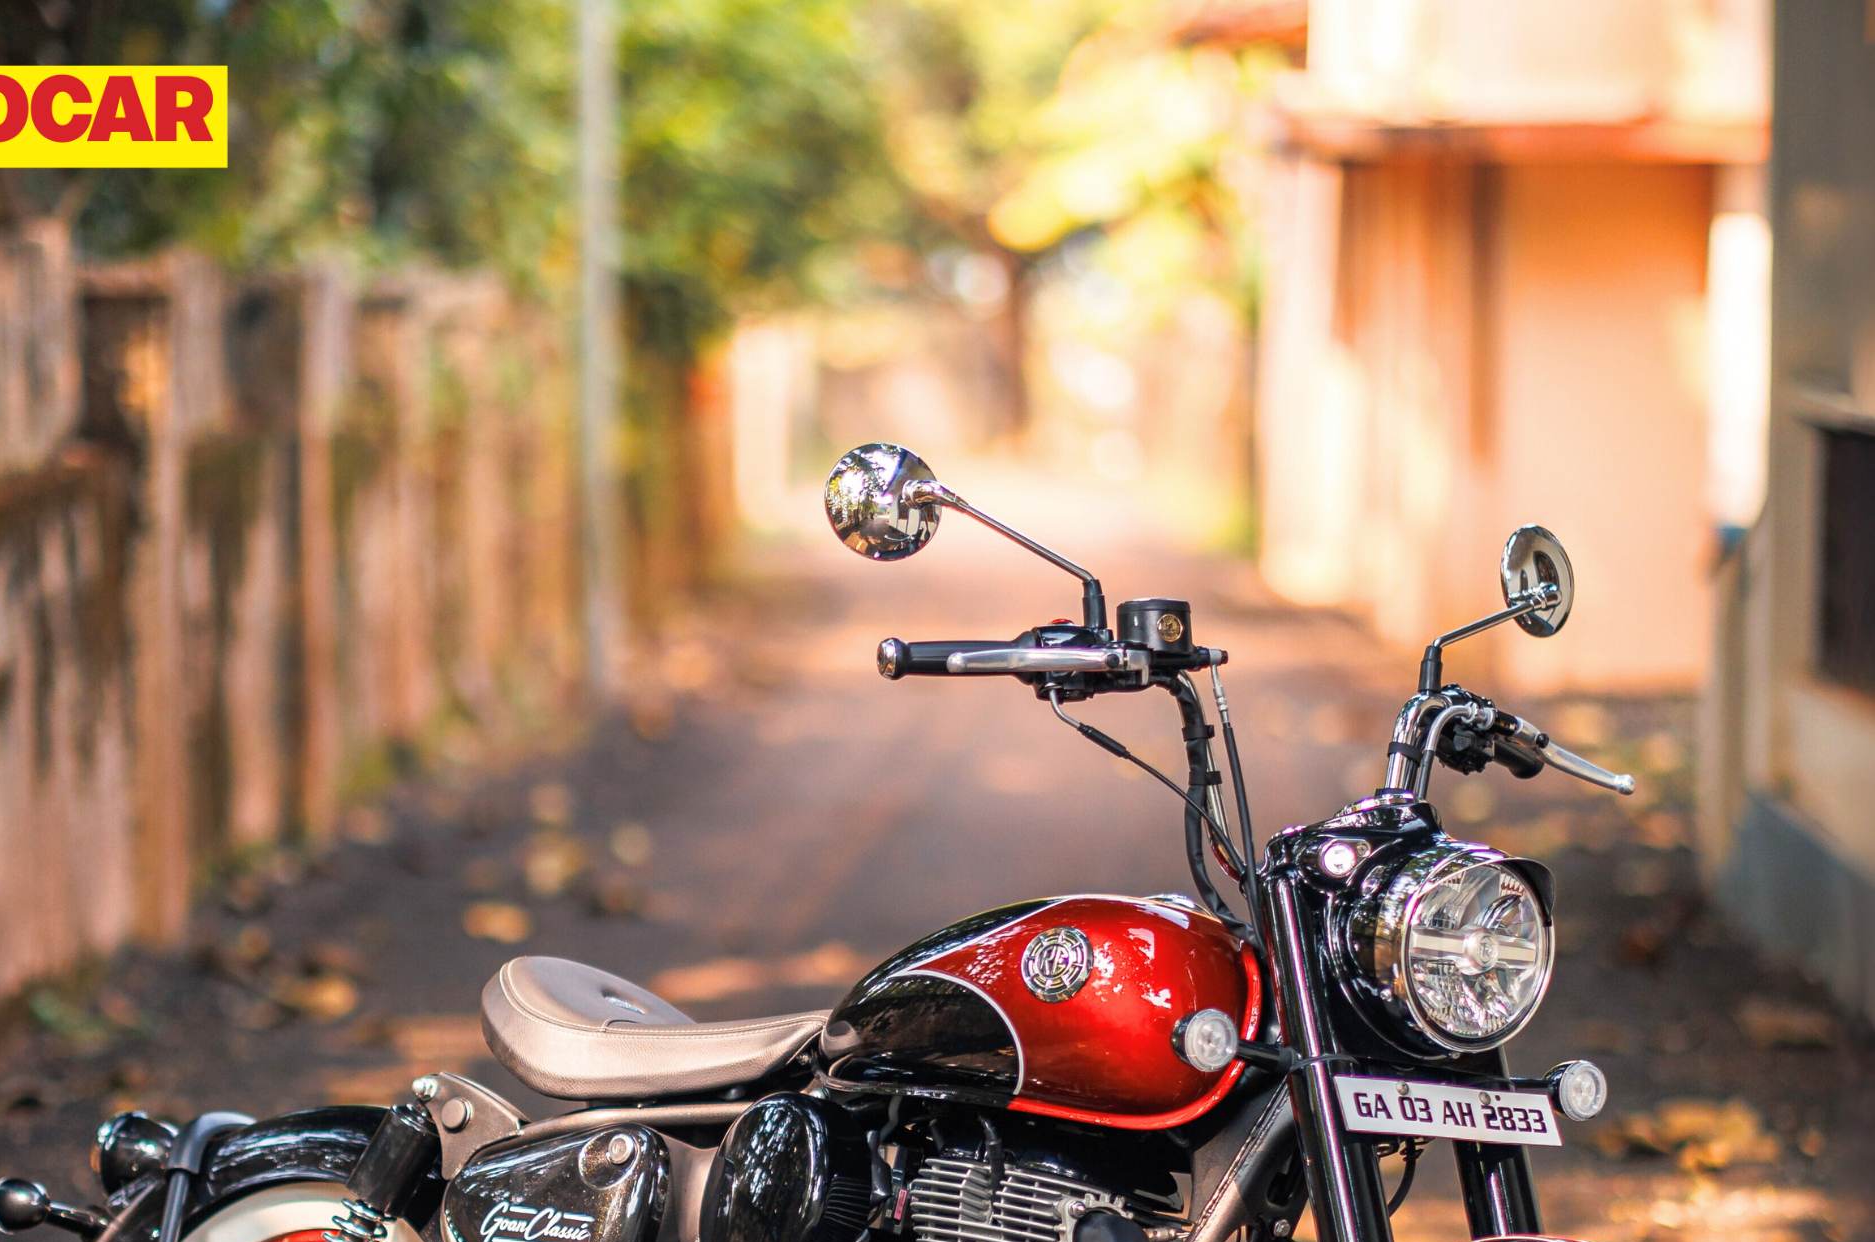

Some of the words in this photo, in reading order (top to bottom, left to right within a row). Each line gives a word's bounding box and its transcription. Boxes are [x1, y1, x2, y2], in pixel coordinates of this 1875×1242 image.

[1353, 1092, 1393, 1119] GA
[1398, 1096, 1433, 1123] 03
[1442, 1100, 1476, 1128] AH
[1481, 1104, 1547, 1133] 2833
[524, 1207, 590, 1241] Classic
